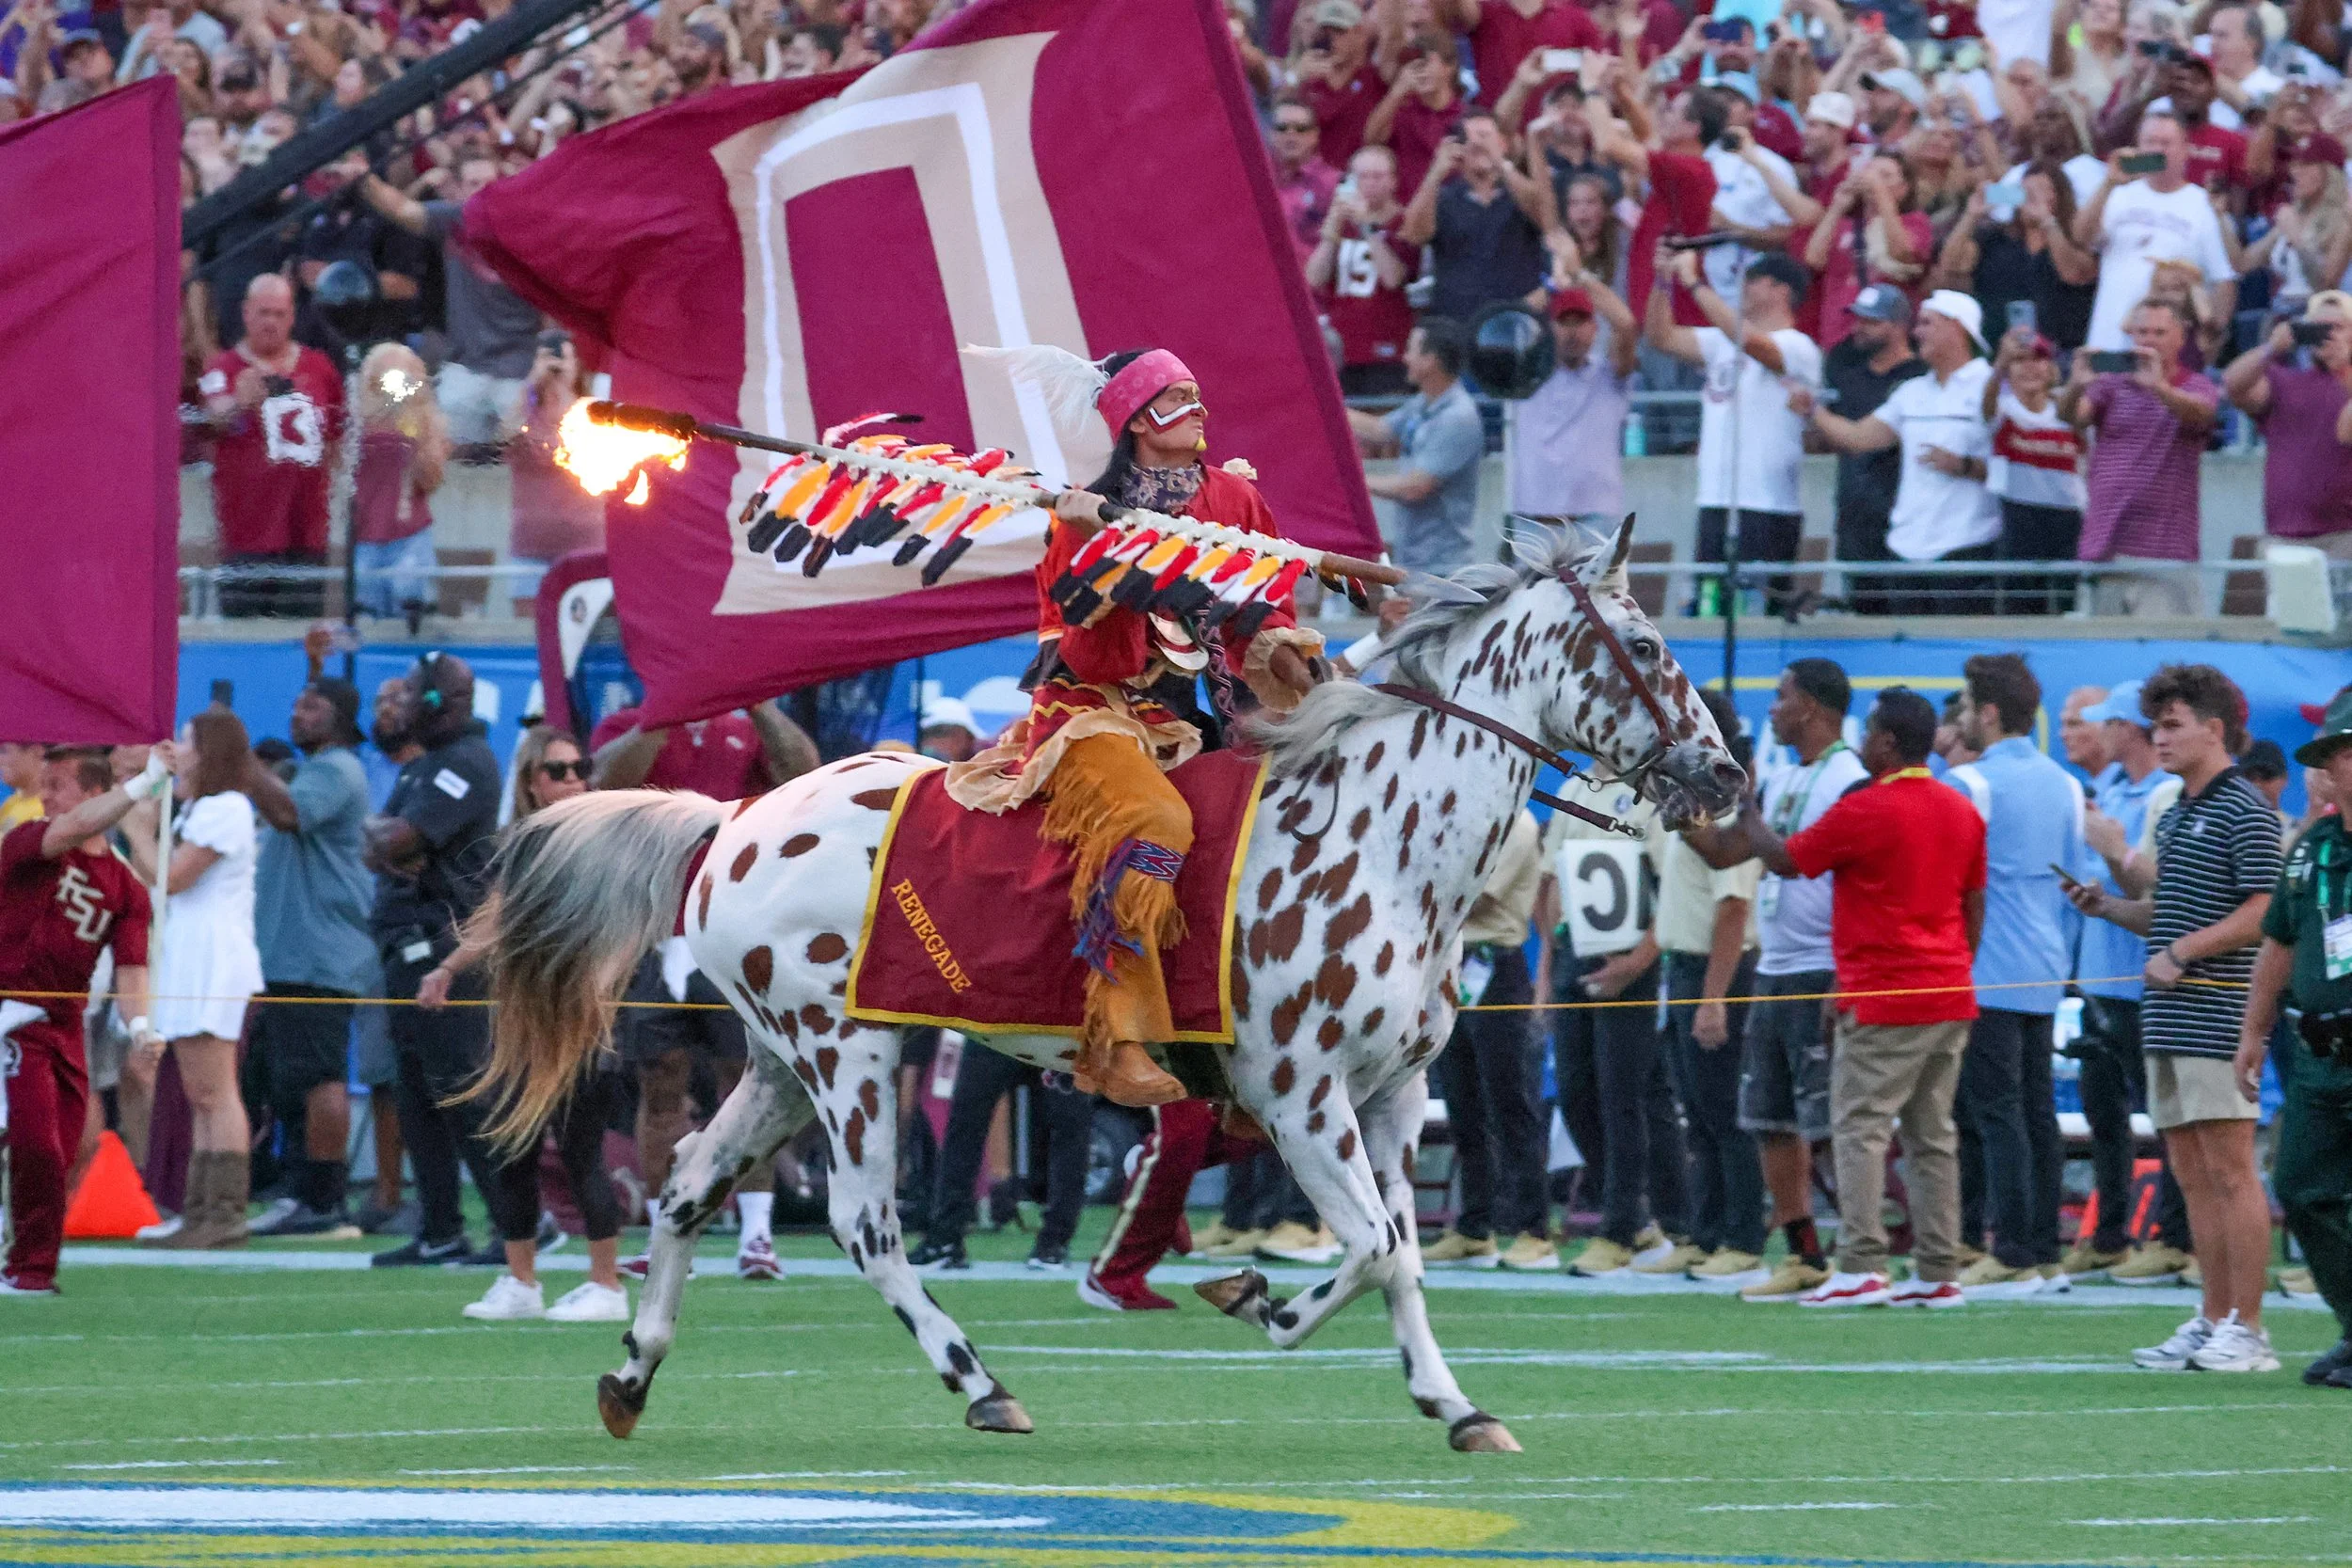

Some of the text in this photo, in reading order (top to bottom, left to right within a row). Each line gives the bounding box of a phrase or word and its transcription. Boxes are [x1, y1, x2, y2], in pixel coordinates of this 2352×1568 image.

[1337, 239, 1377, 297] 15
[56, 865, 113, 943] FSU
[890, 879, 973, 994] RENEGADE
